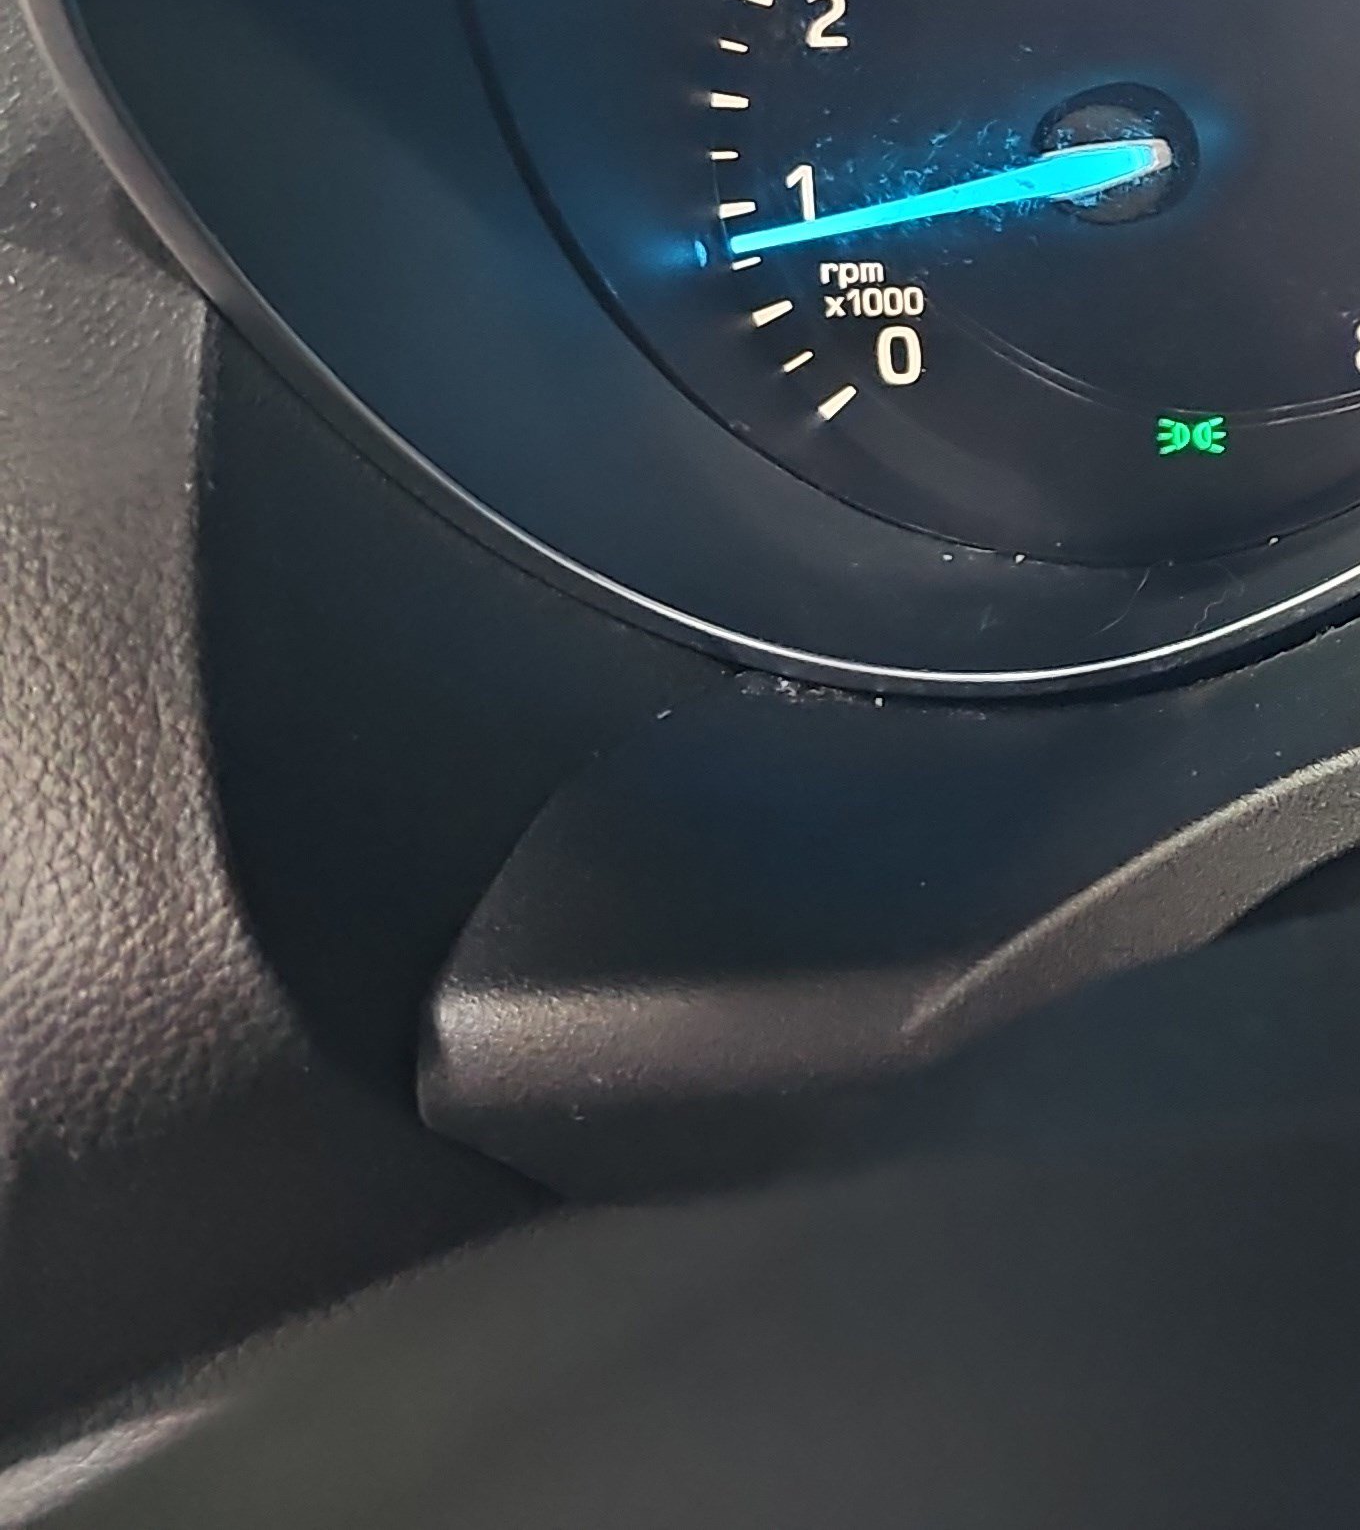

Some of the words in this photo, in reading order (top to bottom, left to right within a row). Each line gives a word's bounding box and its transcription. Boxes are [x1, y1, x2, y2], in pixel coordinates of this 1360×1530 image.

[786, 164, 816, 221] 1
[819, 261, 884, 288] rpm
[824, 286, 924, 318] x1000
[876, 325, 923, 386] 0
